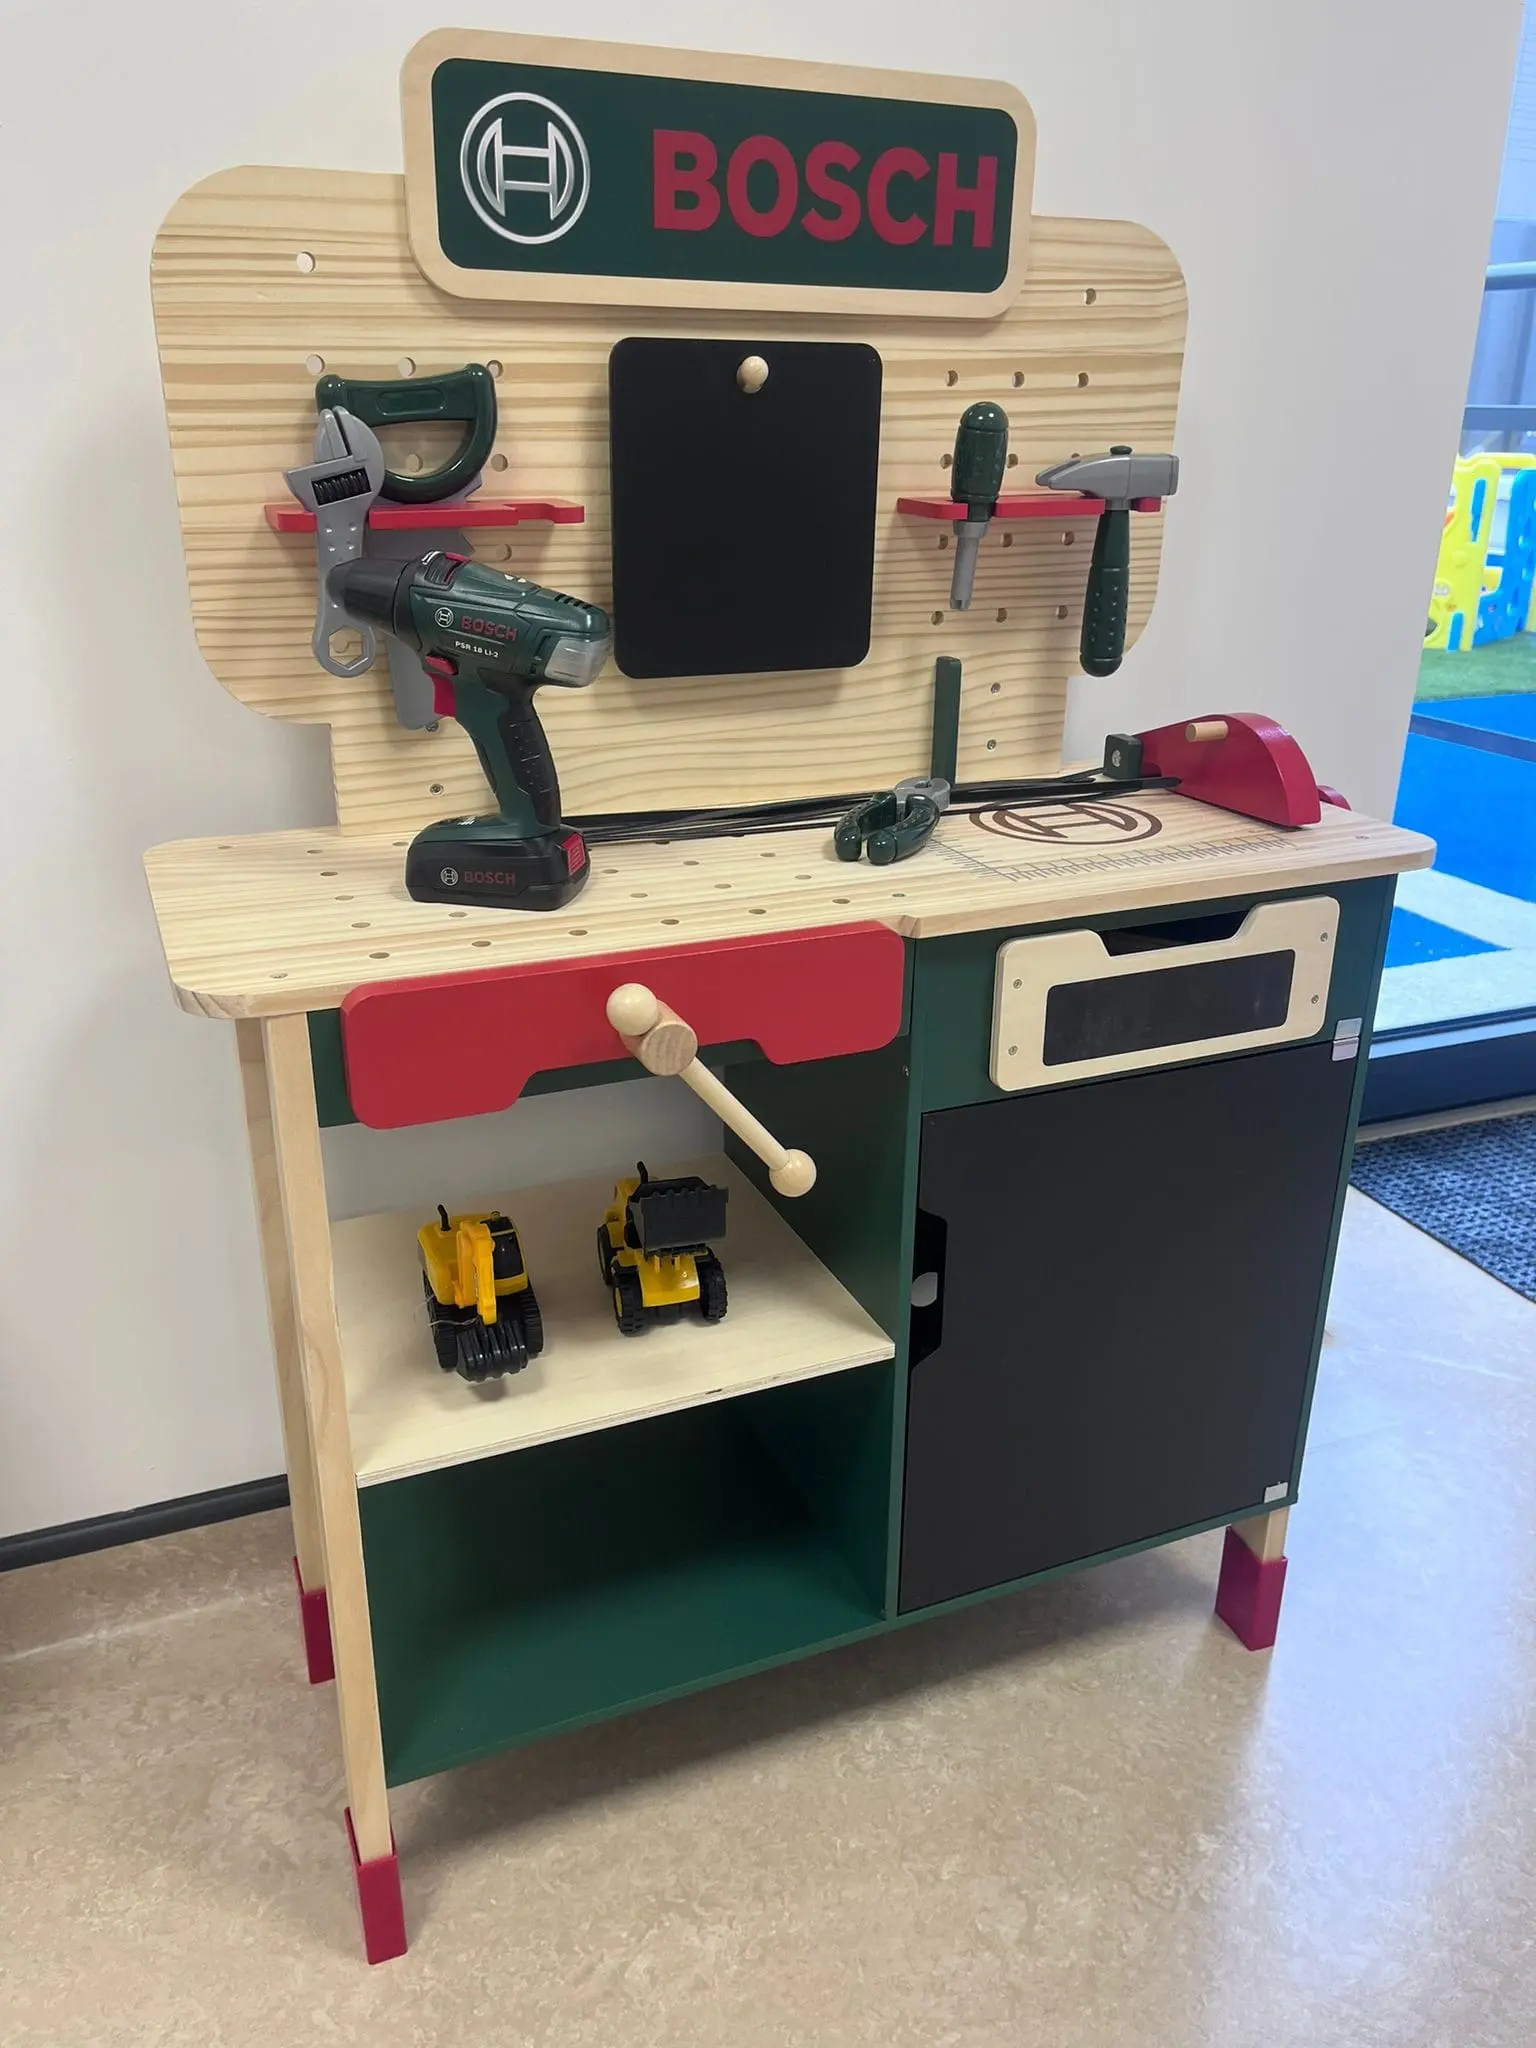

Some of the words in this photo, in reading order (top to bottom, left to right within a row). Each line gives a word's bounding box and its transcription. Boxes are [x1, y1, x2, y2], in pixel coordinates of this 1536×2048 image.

[653, 129, 998, 248] BOSCH
[462, 616, 517, 641] BOSCH
[455, 641, 471, 650] PSR
[464, 871, 516, 886] BOSCH
